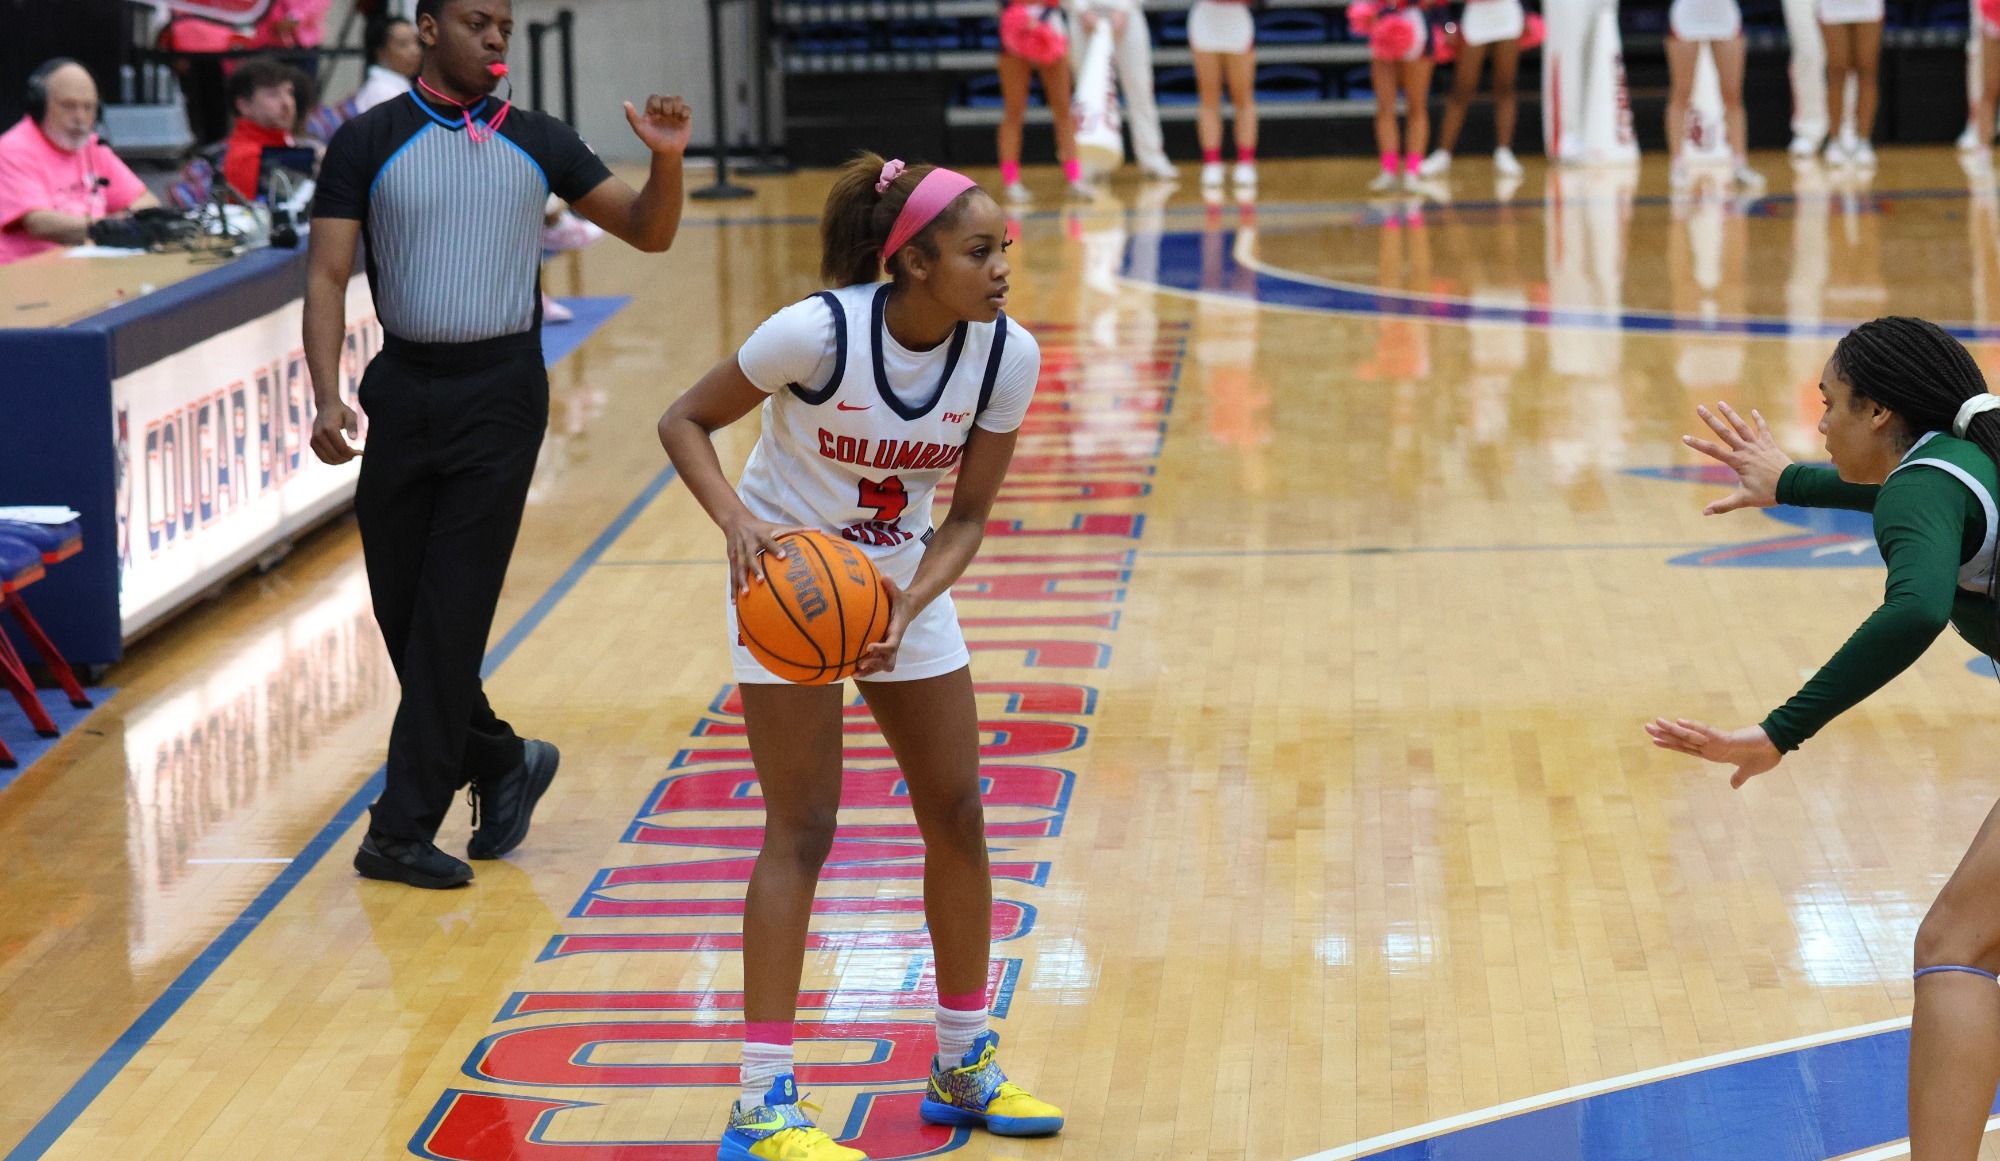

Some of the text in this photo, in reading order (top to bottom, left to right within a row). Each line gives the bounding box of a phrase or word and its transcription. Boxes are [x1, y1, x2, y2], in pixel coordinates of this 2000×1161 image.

[145, 379, 249, 560] COUGAR
[817, 426, 965, 470] COLUMBUS
[857, 474, 909, 522] 4
[780, 536, 830, 624] Wilson
